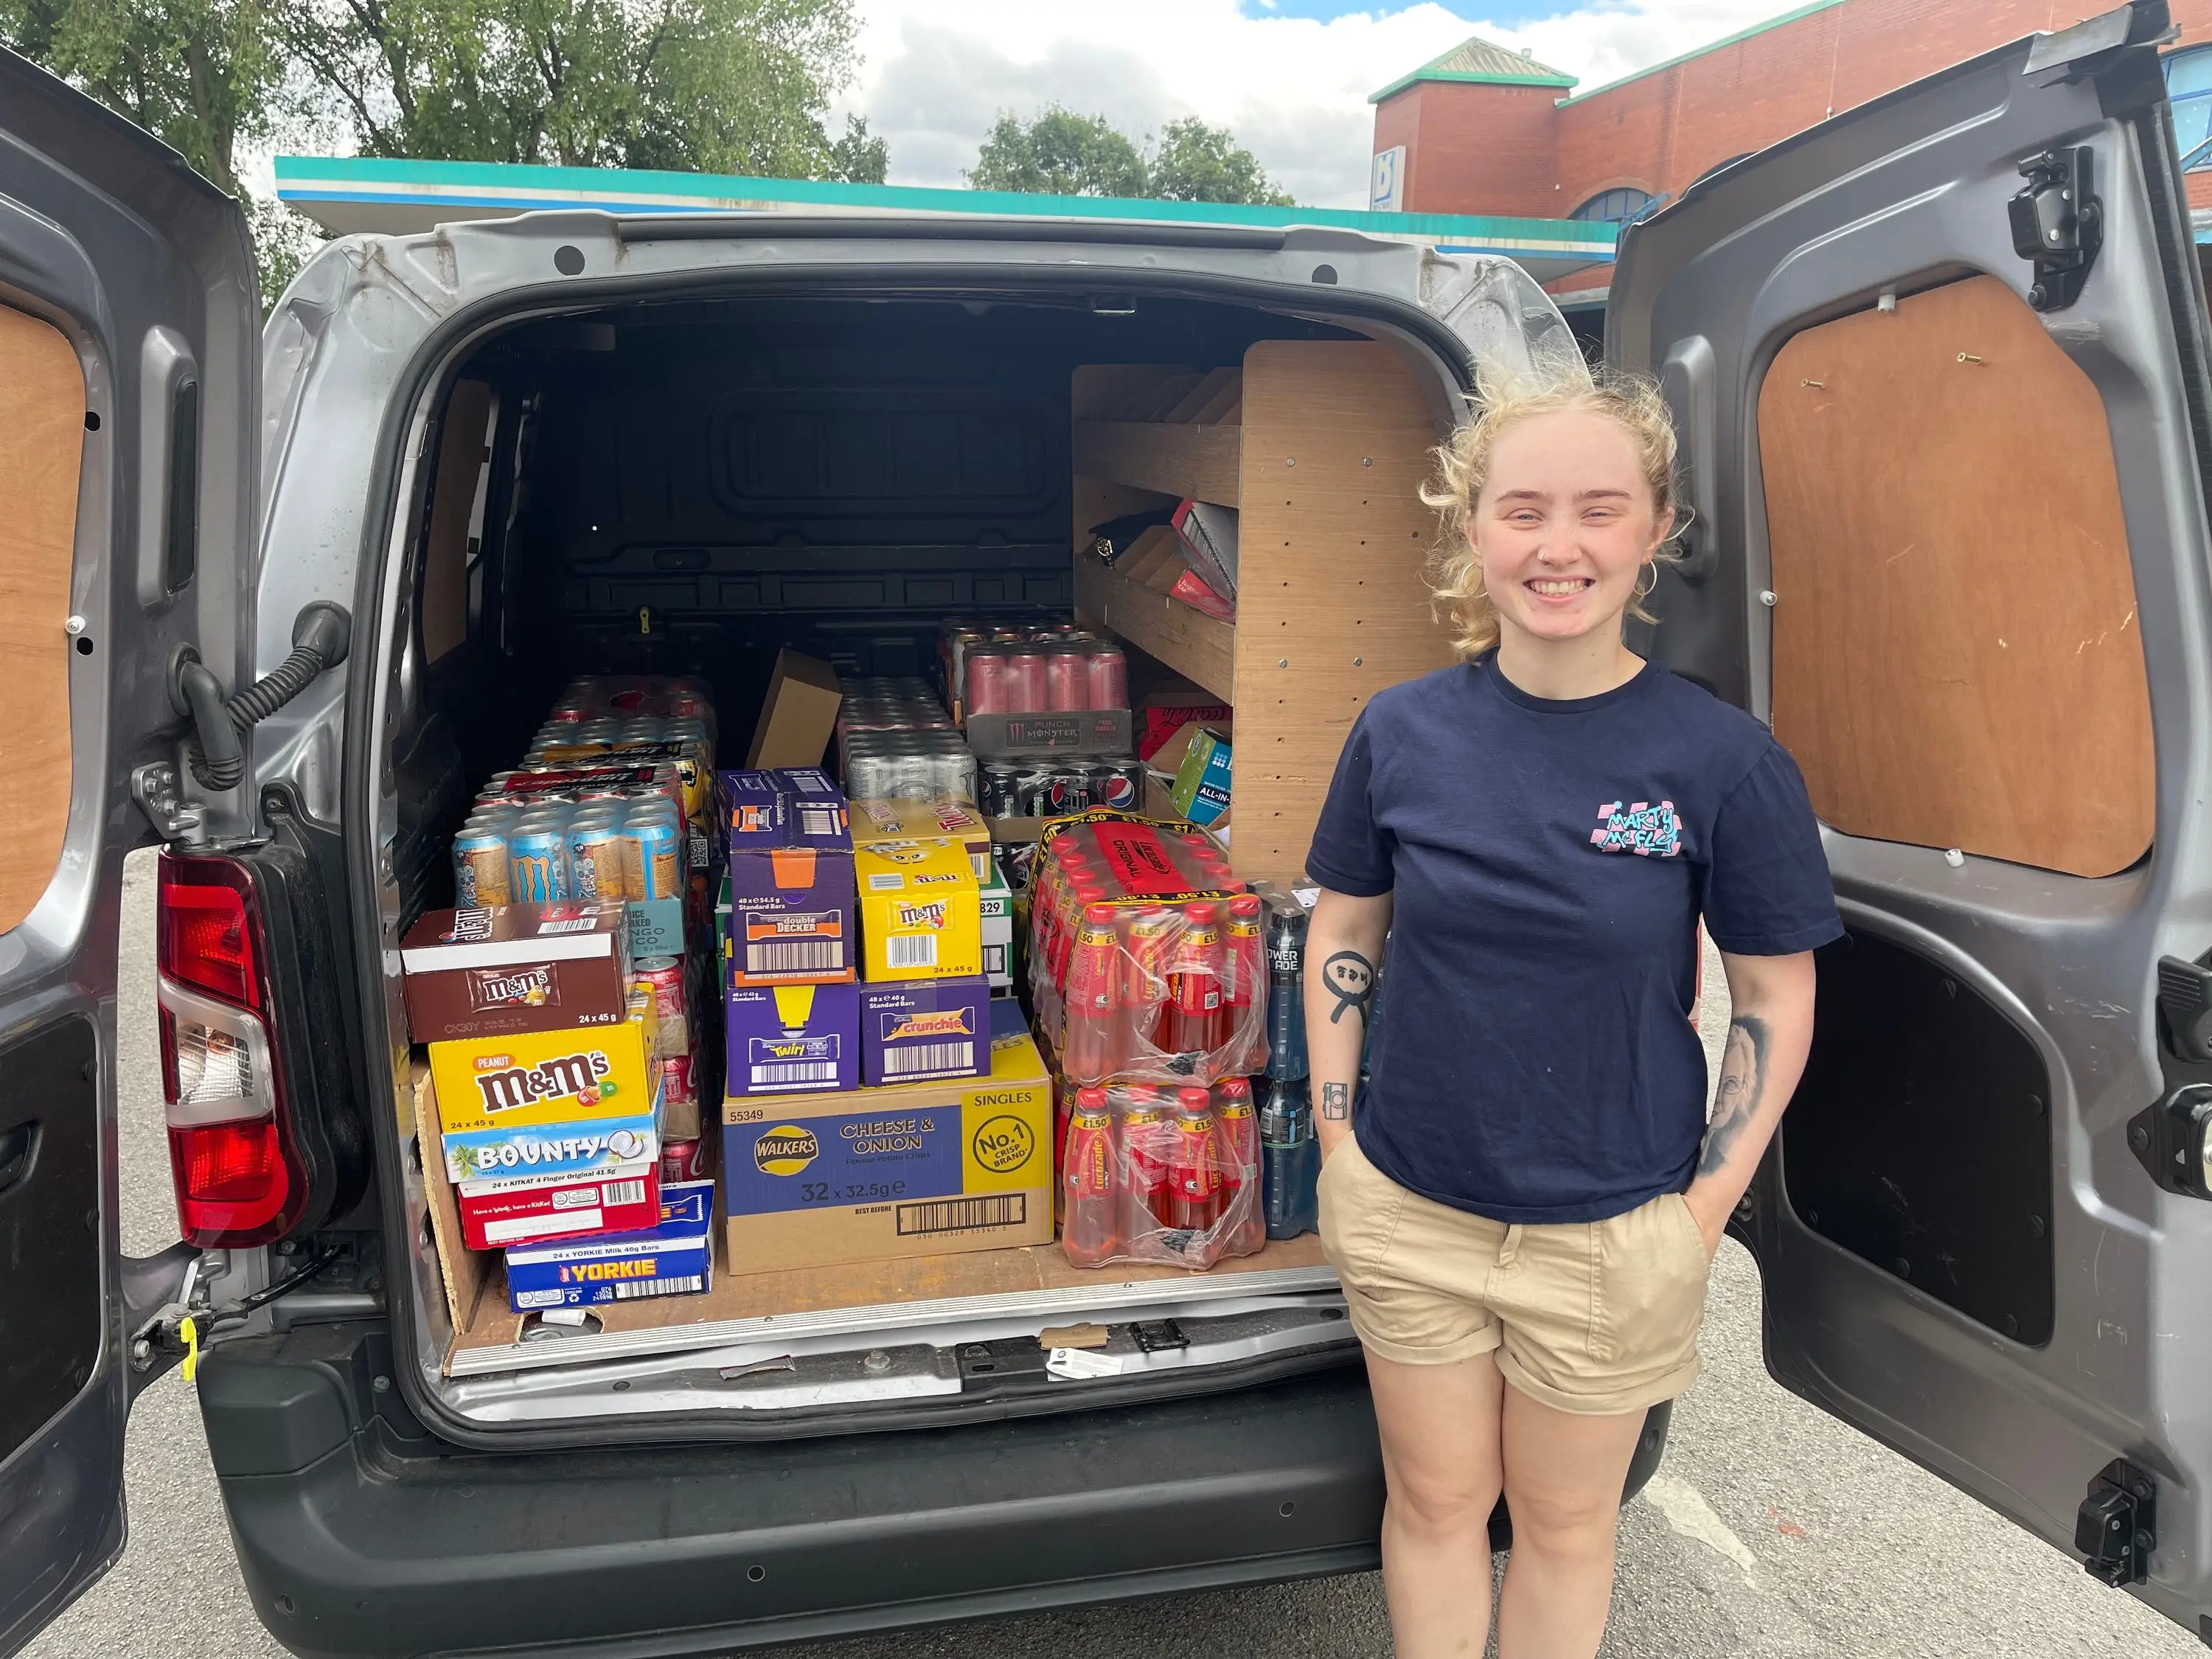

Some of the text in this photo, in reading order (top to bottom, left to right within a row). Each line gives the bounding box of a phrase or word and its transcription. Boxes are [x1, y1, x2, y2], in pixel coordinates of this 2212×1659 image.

[1027, 728, 1079, 738] MONSTER
[1200, 787, 1231, 803] ALL-IN-
[776, 922, 816, 933] DECKER
[784, 916, 816, 925] double
[1203, 933, 1218, 944] £1.5
[1267, 950, 1298, 961] OWER
[483, 970, 548, 1001] m&m's
[869, 1001, 900, 1009] Standard
[579, 1015, 590, 1023] 24
[599, 1014, 609, 1022] 45
[611, 1014, 616, 1022] g
[902, 1018, 963, 1033] crunchie
[478, 1056, 509, 1068] PEANUT
[476, 1052, 610, 1113] m&m's
[974, 1092, 1032, 1107] SINGLES
[730, 1110, 763, 1121] 55349
[840, 1117, 935, 1139] CHEESE &
[1083, 1118, 1107, 1129] £1.50
[757, 1139, 815, 1157] WALKERS
[852, 1135, 922, 1154] ONION
[995, 1144, 1020, 1159] CRISP
[477, 1136, 602, 1170] BOUNTY
[846, 1152, 931, 1165] Flavour Potato Crisps
[1094, 1140, 1104, 1191] Lucozade
[509, 1178, 534, 1187] KITKAT
[543, 1175, 566, 1183] Finger
[567, 1171, 594, 1180] Original
[596, 1168, 616, 1176] 41.5g
[801, 1183, 829, 1202] 32
[834, 1190, 841, 1199] x
[846, 1183, 889, 1197] 32.5g
[855, 1205, 892, 1215] BEST BEFORE
[570, 1258, 657, 1282] YORKIE
